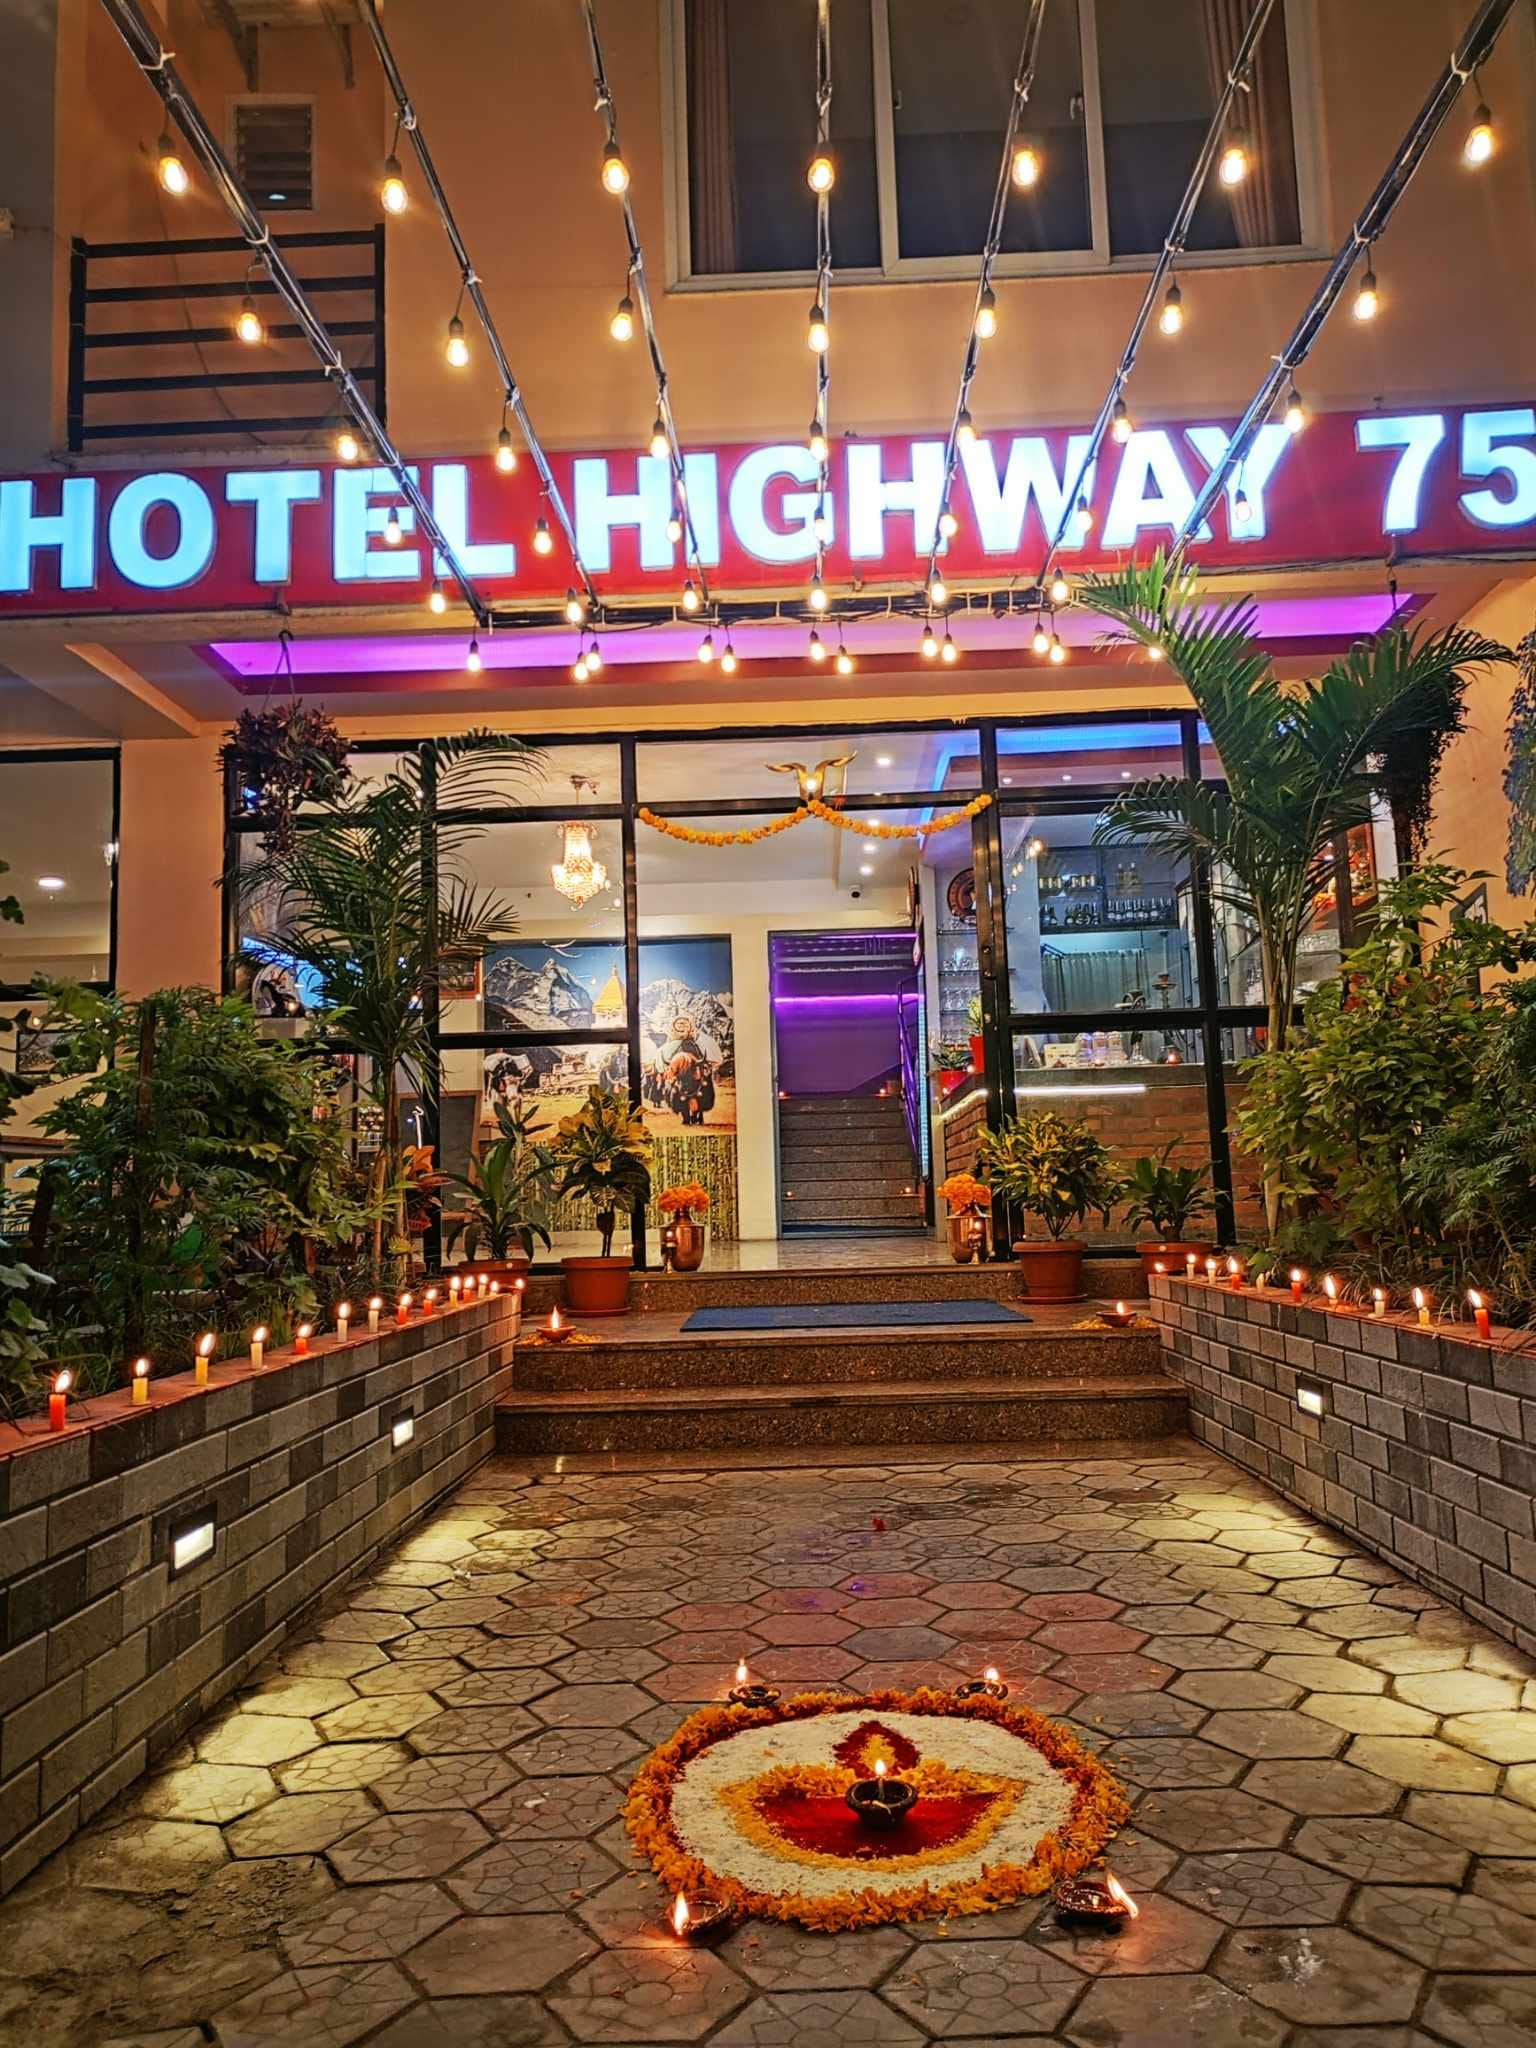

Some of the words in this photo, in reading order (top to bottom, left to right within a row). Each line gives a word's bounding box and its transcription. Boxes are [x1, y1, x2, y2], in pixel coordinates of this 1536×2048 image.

[0, 464, 517, 592] HOTEL
[572, 423, 1294, 571] HIGHWAY
[1356, 408, 1536, 533] 75
